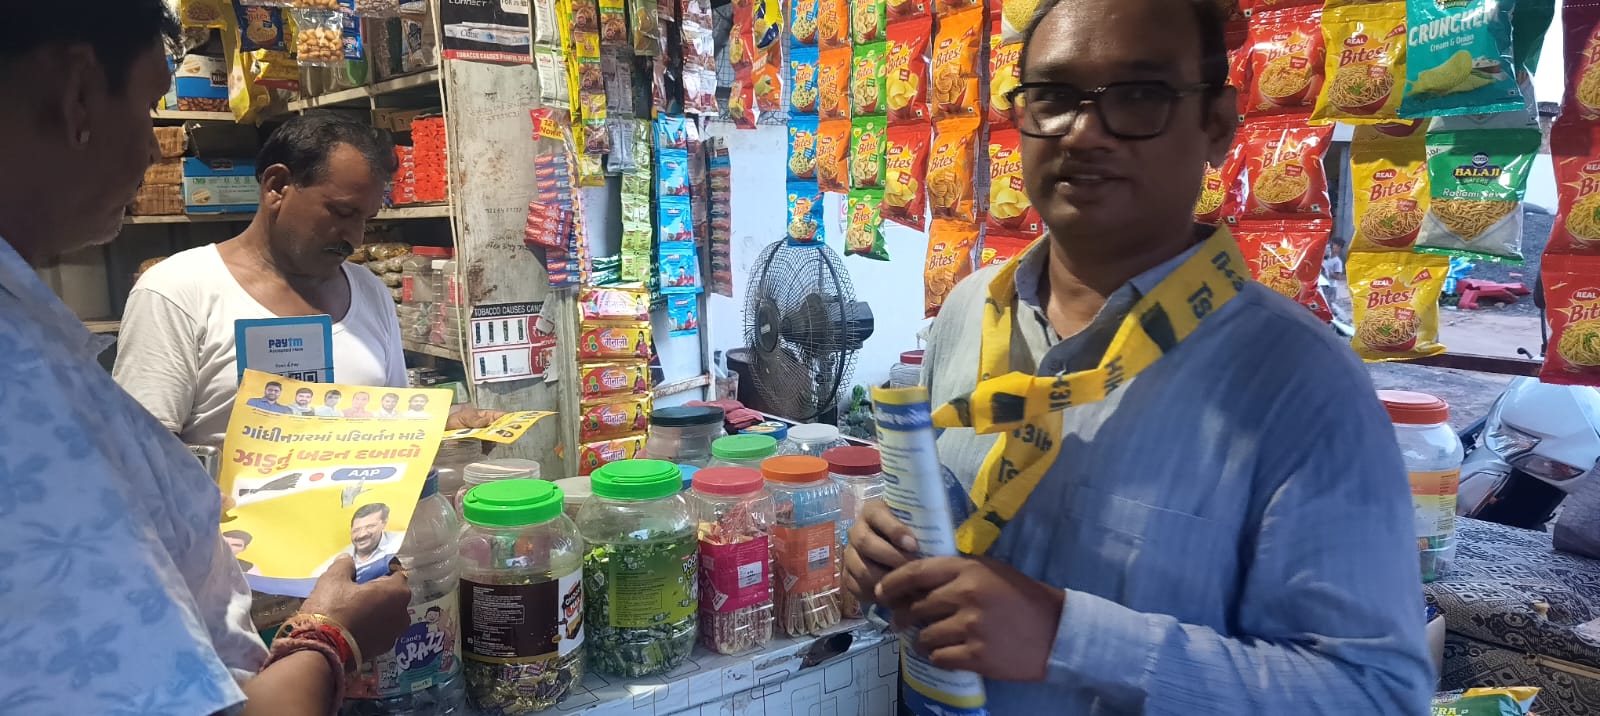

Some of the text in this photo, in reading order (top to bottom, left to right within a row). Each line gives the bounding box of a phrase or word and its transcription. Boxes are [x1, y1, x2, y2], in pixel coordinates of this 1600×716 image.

[1340, 42, 1391, 67] Bites!
[1374, 171, 1394, 179] REAL
[1454, 168, 1500, 177] BALAJI
[1369, 177, 1419, 201] Bites!
[928, 252, 959, 269] Bites!
[1367, 287, 1417, 309] Bites!
[1575, 291, 1597, 299] REAL
[474, 307, 501, 317] TOBACCO
[502, 305, 526, 314] CAUSES
[242, 425, 426, 444] ગાંધીનગરમાં પરિવર્તન માટે
[296, 449, 351, 462] બટન
[354, 443, 421, 460] દબાવો
[348, 469, 380, 477] AAP
[397, 631, 445, 671] CRAZZ
